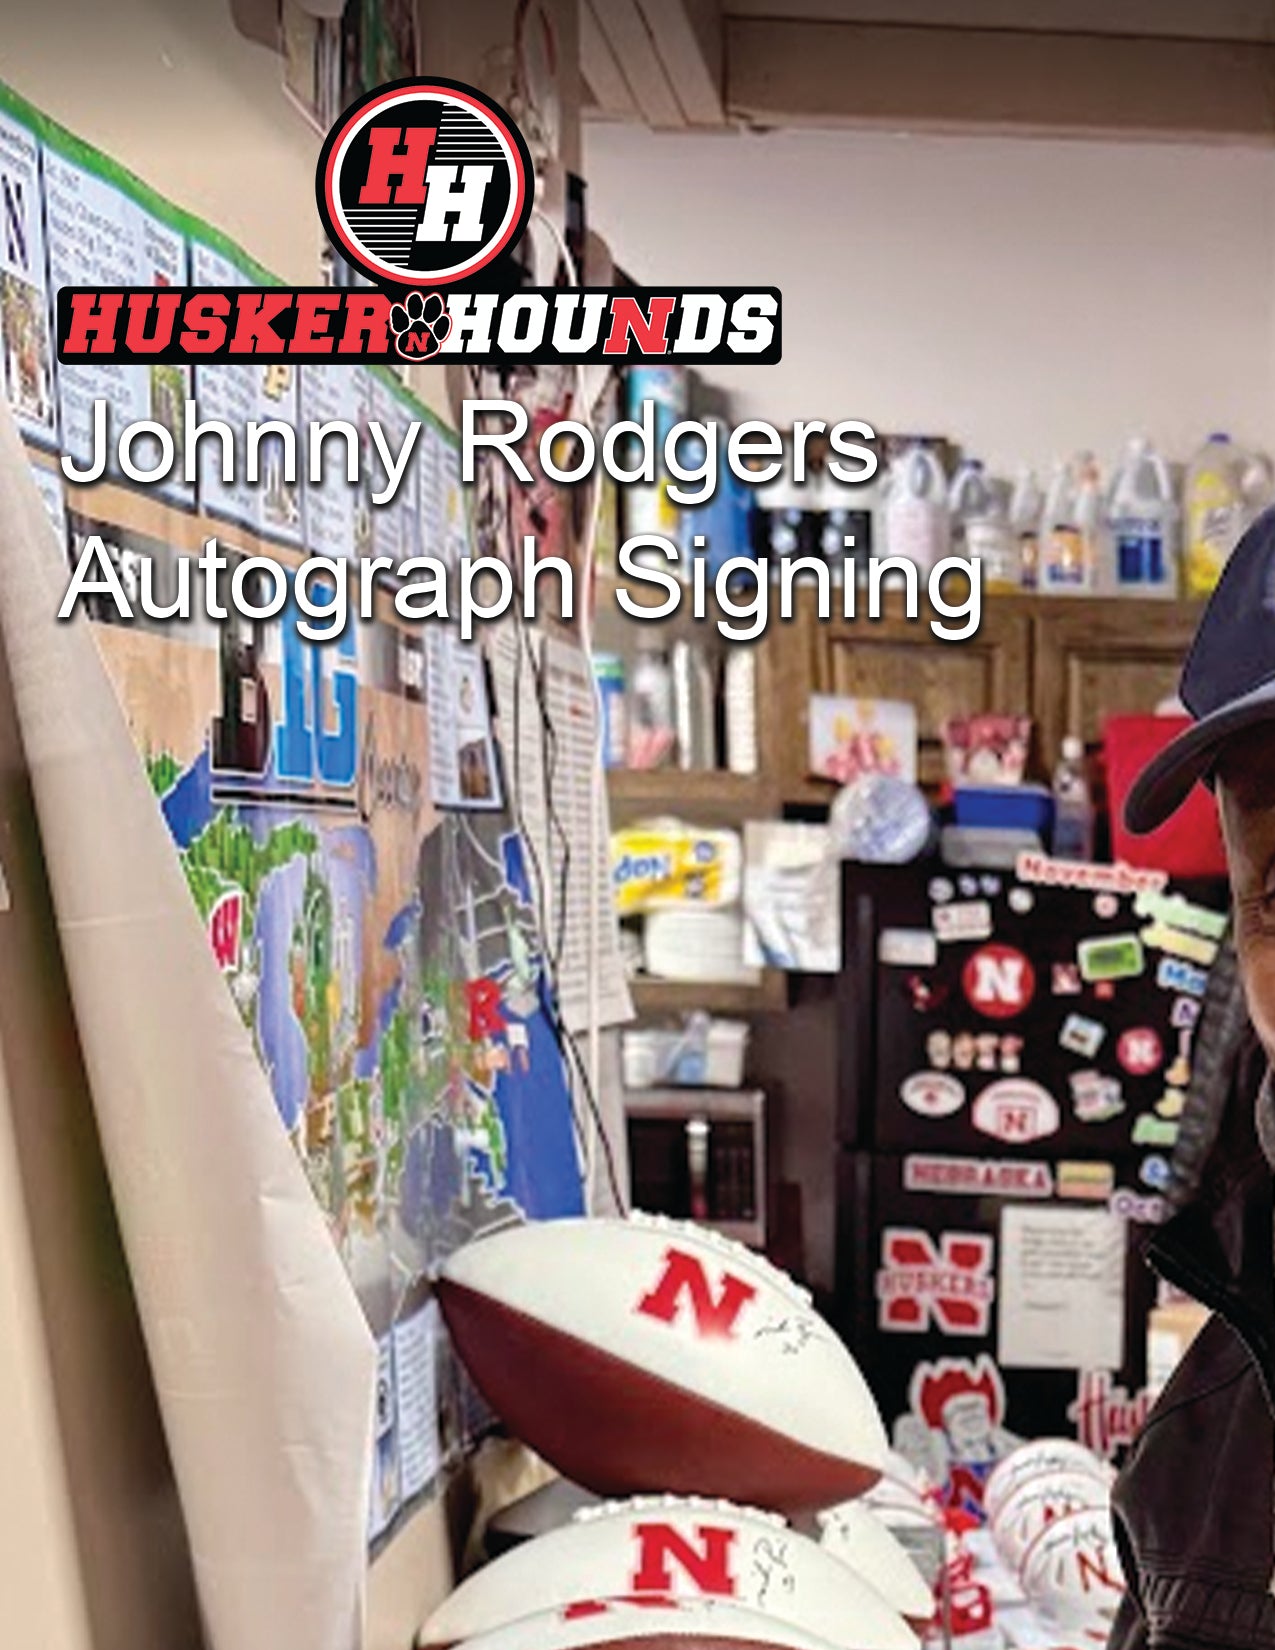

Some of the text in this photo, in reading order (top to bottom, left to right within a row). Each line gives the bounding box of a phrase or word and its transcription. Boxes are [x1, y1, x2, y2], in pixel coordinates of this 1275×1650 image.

[1022, 853, 1166, 891] November
[973, 955, 1024, 1003] N
[911, 1162, 1047, 1190] NEBRASKA
[636, 1247, 757, 1344] N
[878, 1271, 991, 1298] HUSKERS
[633, 1523, 739, 1597] N
